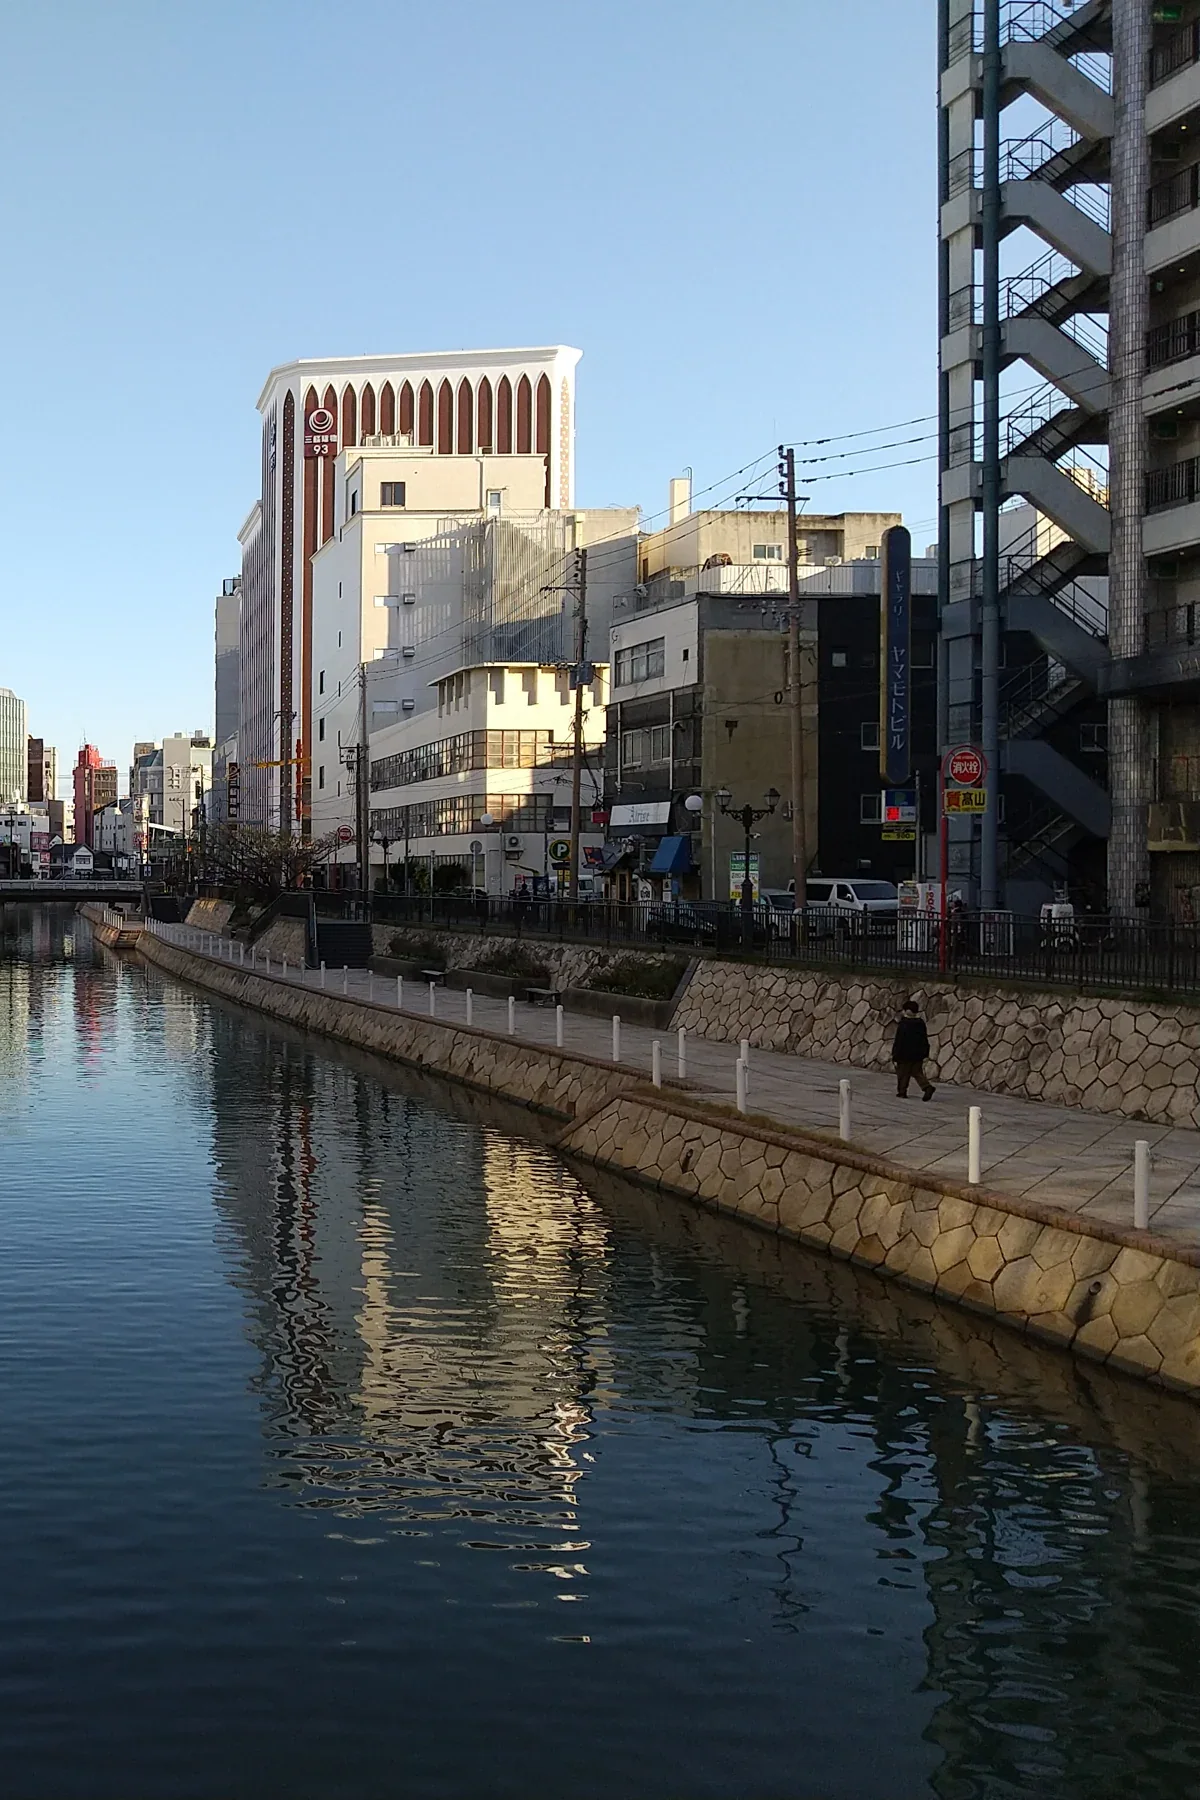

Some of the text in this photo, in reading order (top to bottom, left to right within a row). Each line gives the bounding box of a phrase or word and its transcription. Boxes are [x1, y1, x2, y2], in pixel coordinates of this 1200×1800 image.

[313, 444, 329, 455] 93
[890, 645, 906, 750] ヤマモトビル
[952, 761, 978, 774] 消火栓
[557, 844, 568, 856] P
